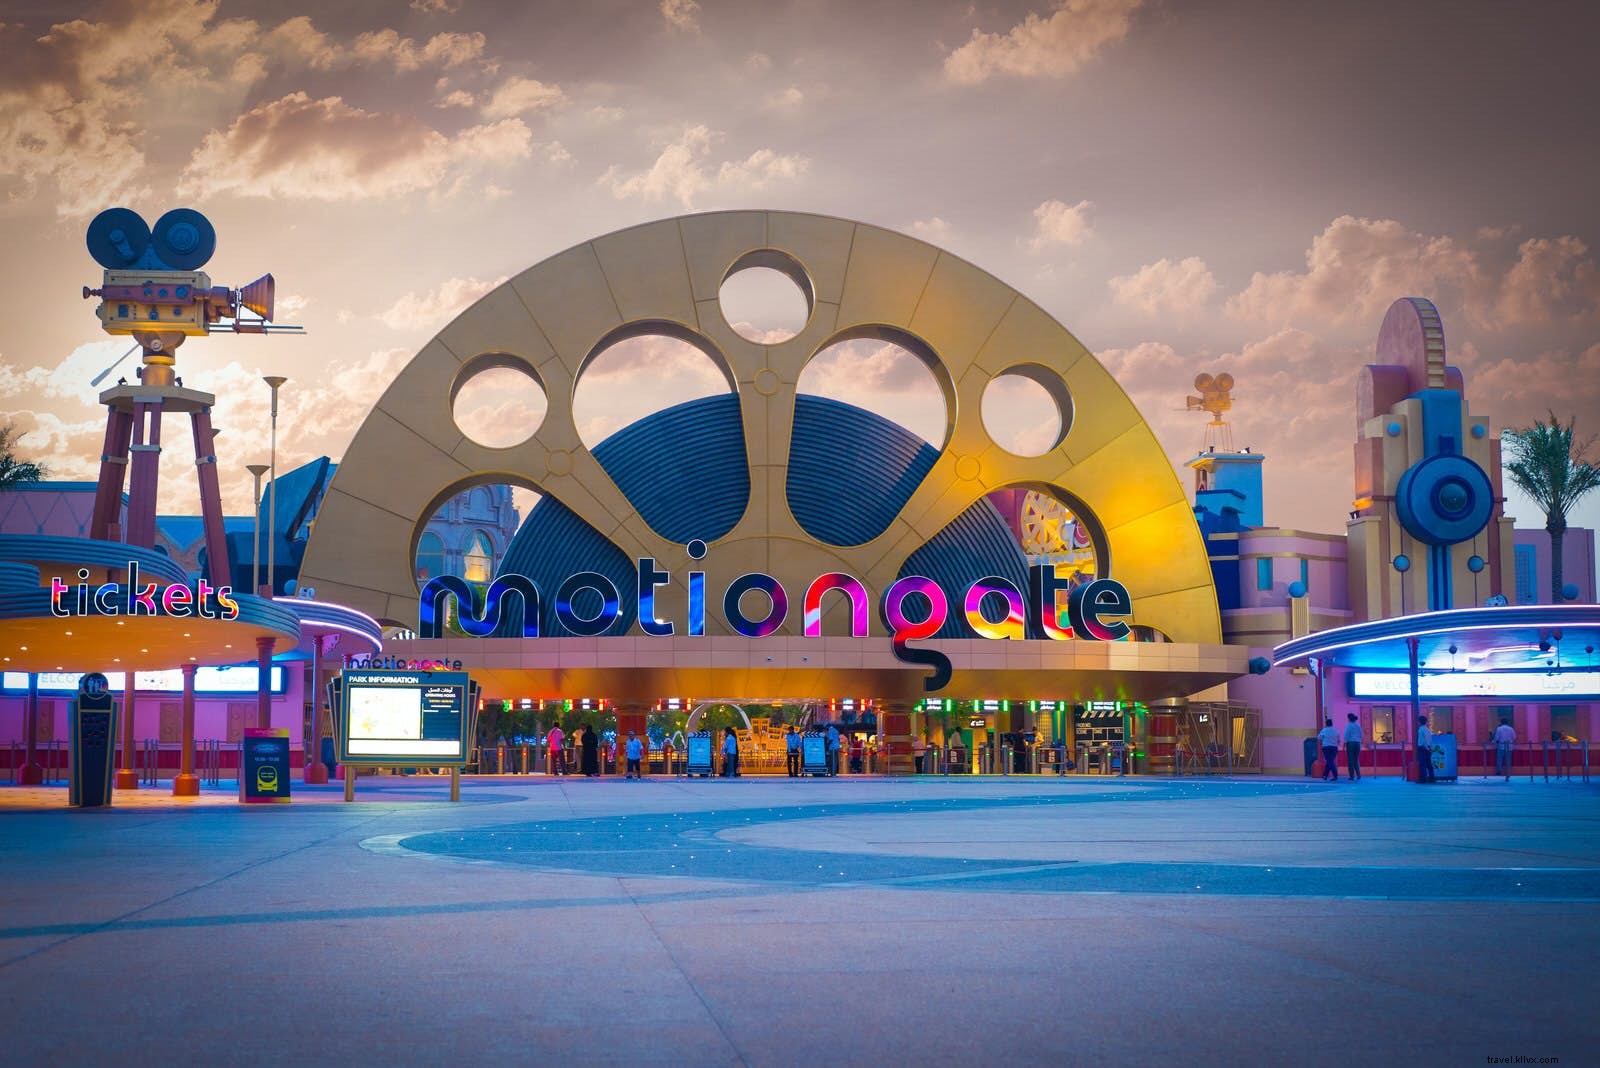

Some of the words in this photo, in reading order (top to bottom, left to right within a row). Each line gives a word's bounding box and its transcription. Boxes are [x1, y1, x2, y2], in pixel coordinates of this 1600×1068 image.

[51, 561, 240, 621] tickets
[419, 538, 1133, 692] motiongate
[348, 675, 367, 683] PARK
[368, 676, 419, 684] INFORMATION
